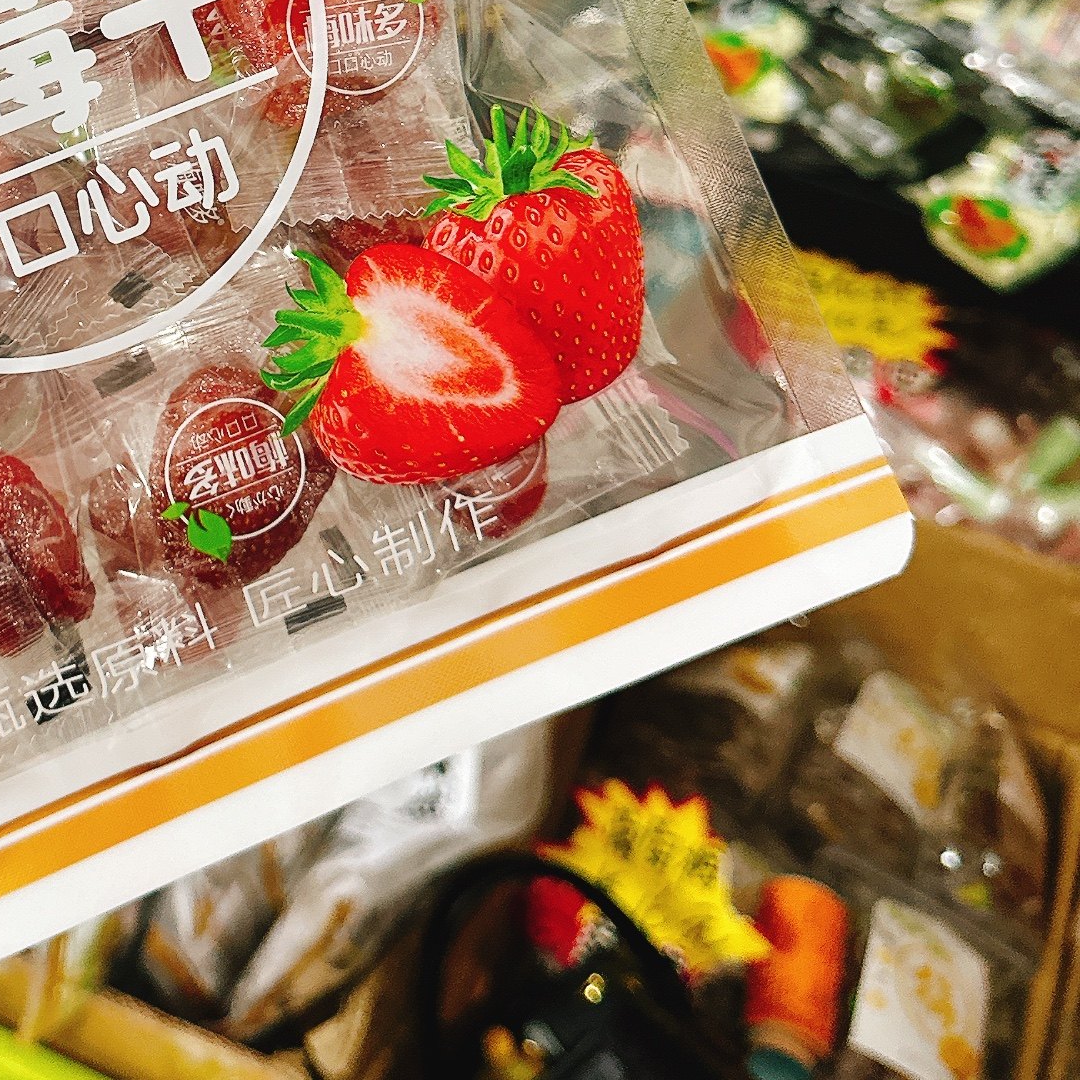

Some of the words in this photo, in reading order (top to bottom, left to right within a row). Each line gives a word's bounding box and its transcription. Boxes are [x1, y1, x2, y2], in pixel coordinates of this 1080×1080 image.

[183, 431, 289, 501] 梅味多
[242, 490, 499, 628] 匠心制作
